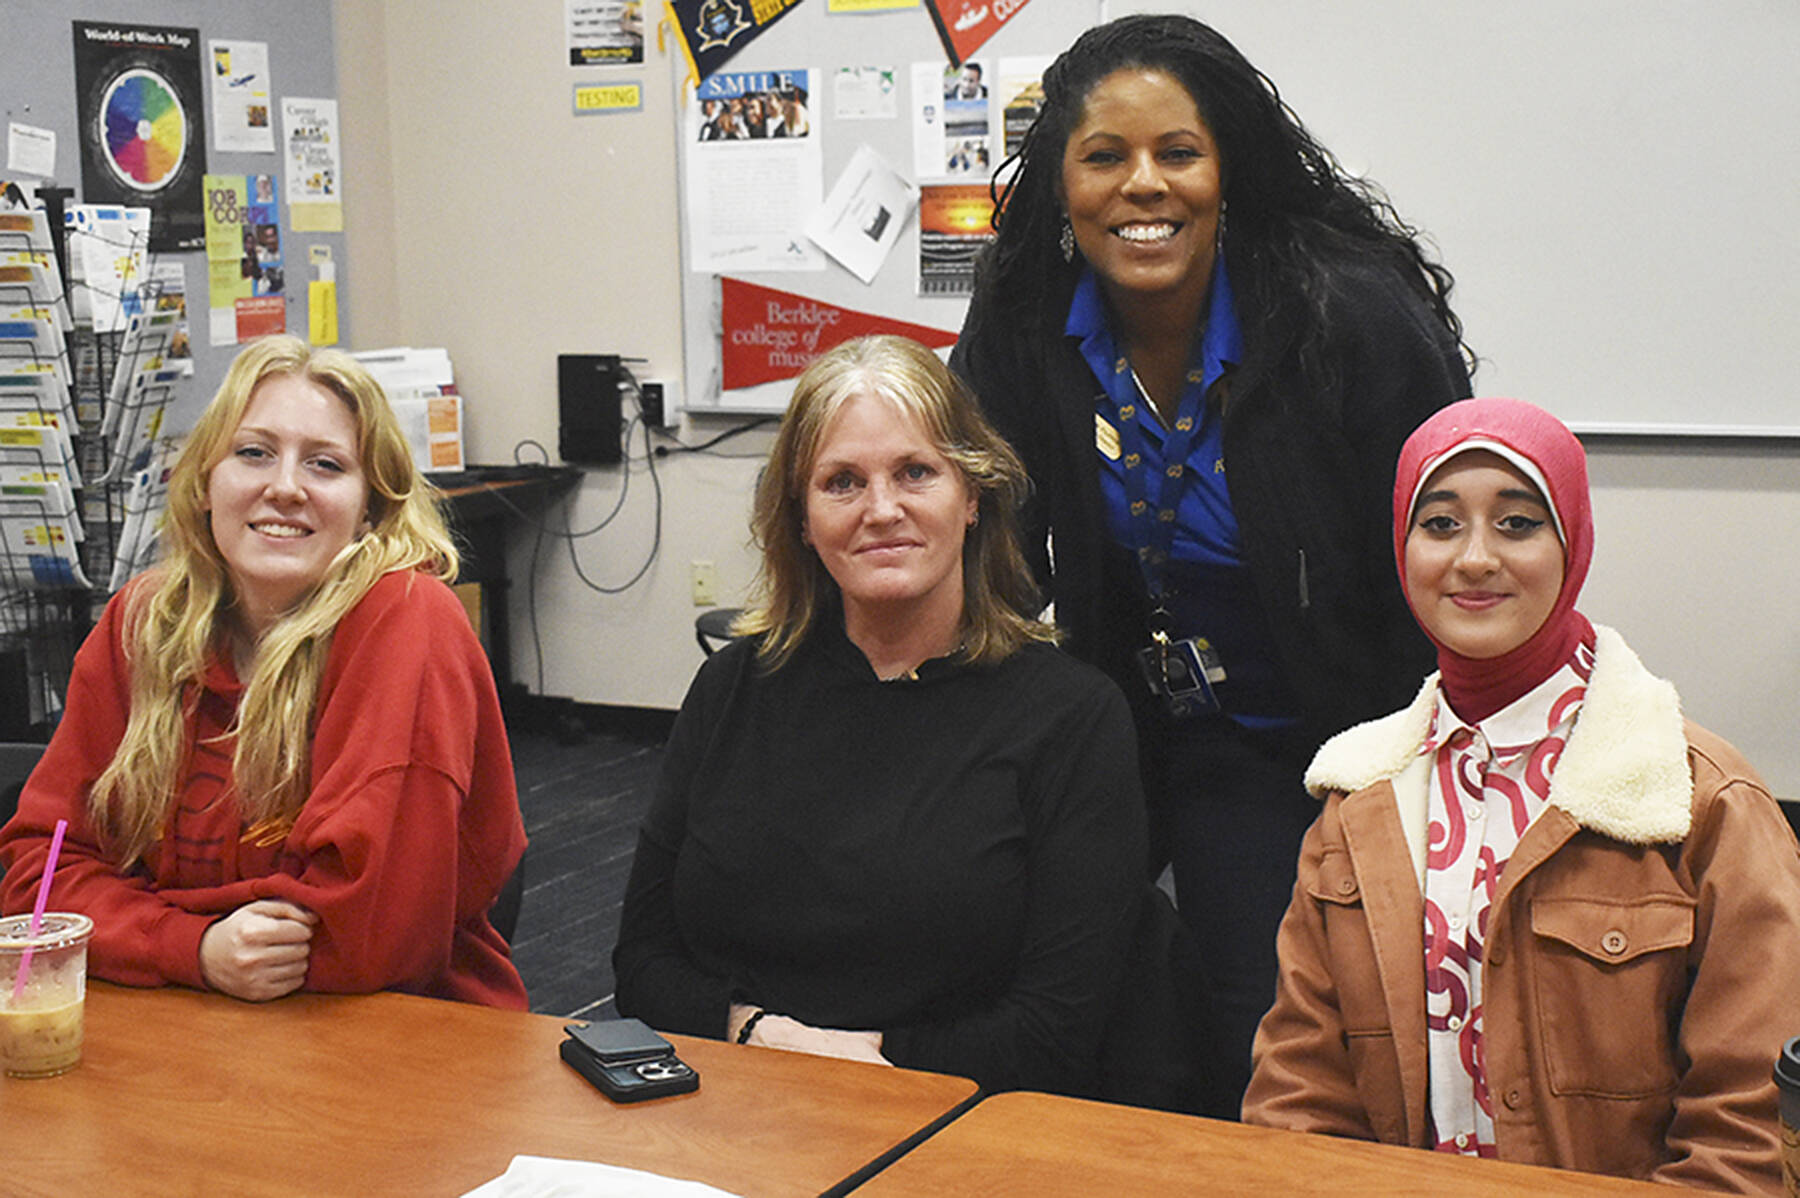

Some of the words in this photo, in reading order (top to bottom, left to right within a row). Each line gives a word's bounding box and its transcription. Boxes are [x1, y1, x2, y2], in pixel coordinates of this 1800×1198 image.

[166, 32, 190, 48] Map
[708, 72, 795, 96] SMILE
[577, 88, 637, 108] TESTING
[207, 188, 237, 211] JOB
[767, 301, 840, 325] Berklee
[732, 322, 798, 352] college
[802, 320, 826, 352] of
